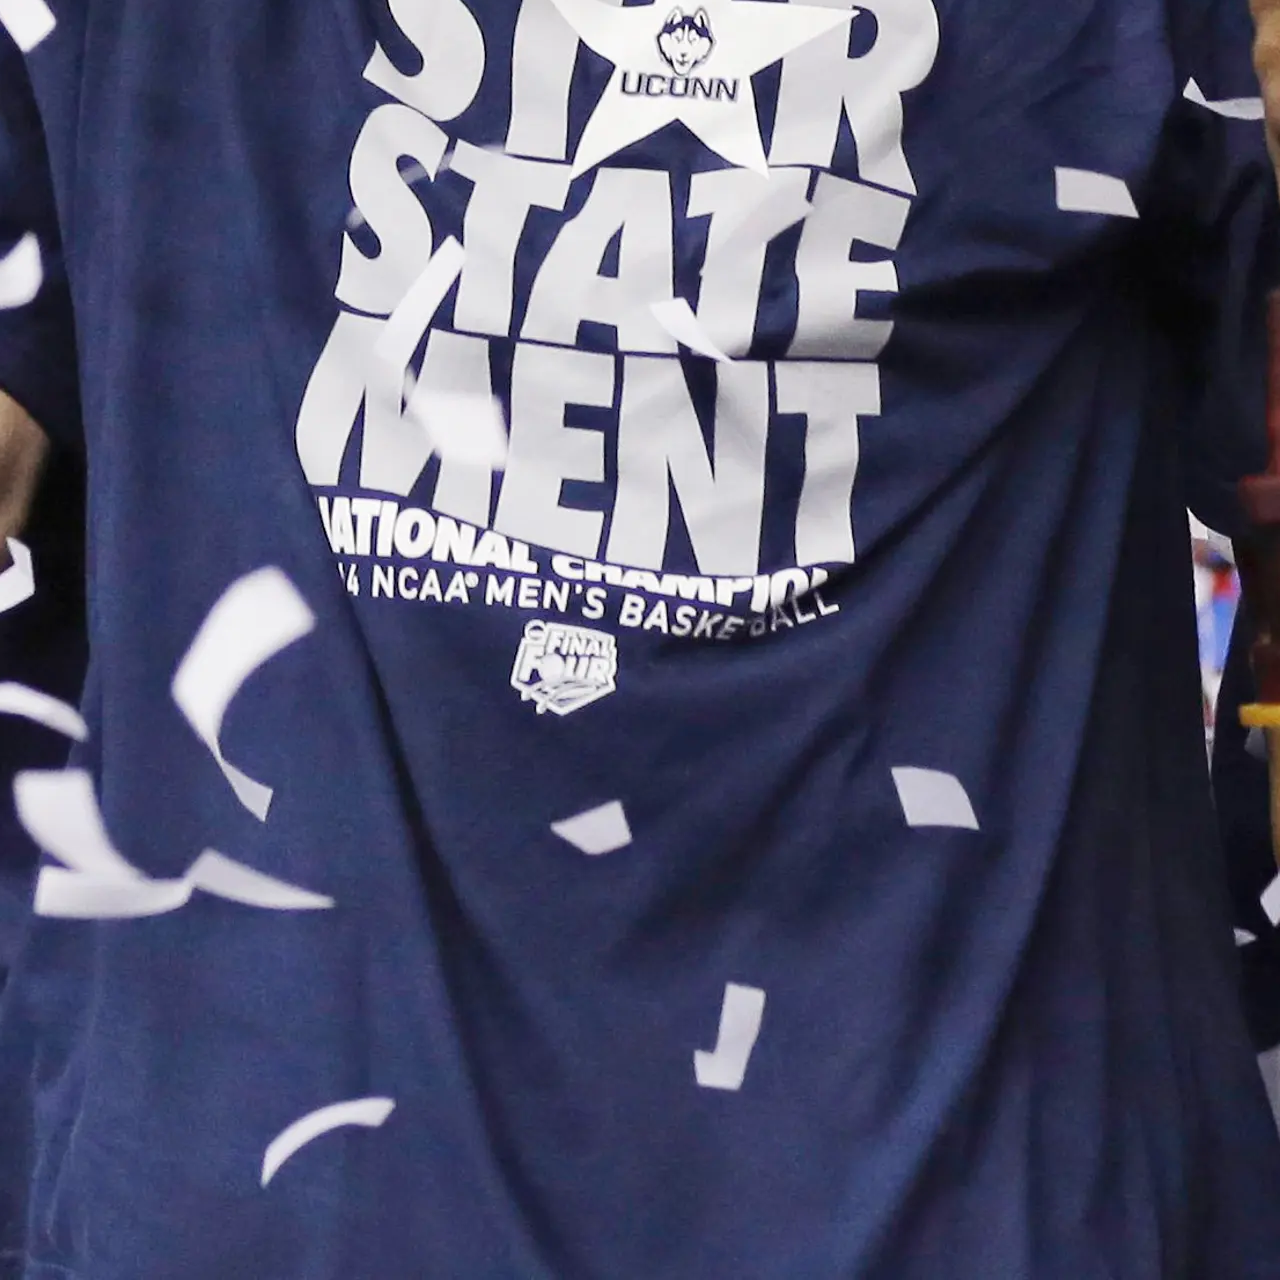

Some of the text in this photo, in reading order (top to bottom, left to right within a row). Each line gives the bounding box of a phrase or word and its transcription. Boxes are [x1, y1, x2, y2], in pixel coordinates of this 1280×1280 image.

[620, 69, 739, 104] UCONN
[335, 103, 912, 363] STATE
[485, 573, 608, 620] MEN'S
[546, 629, 609, 658] FINAL
